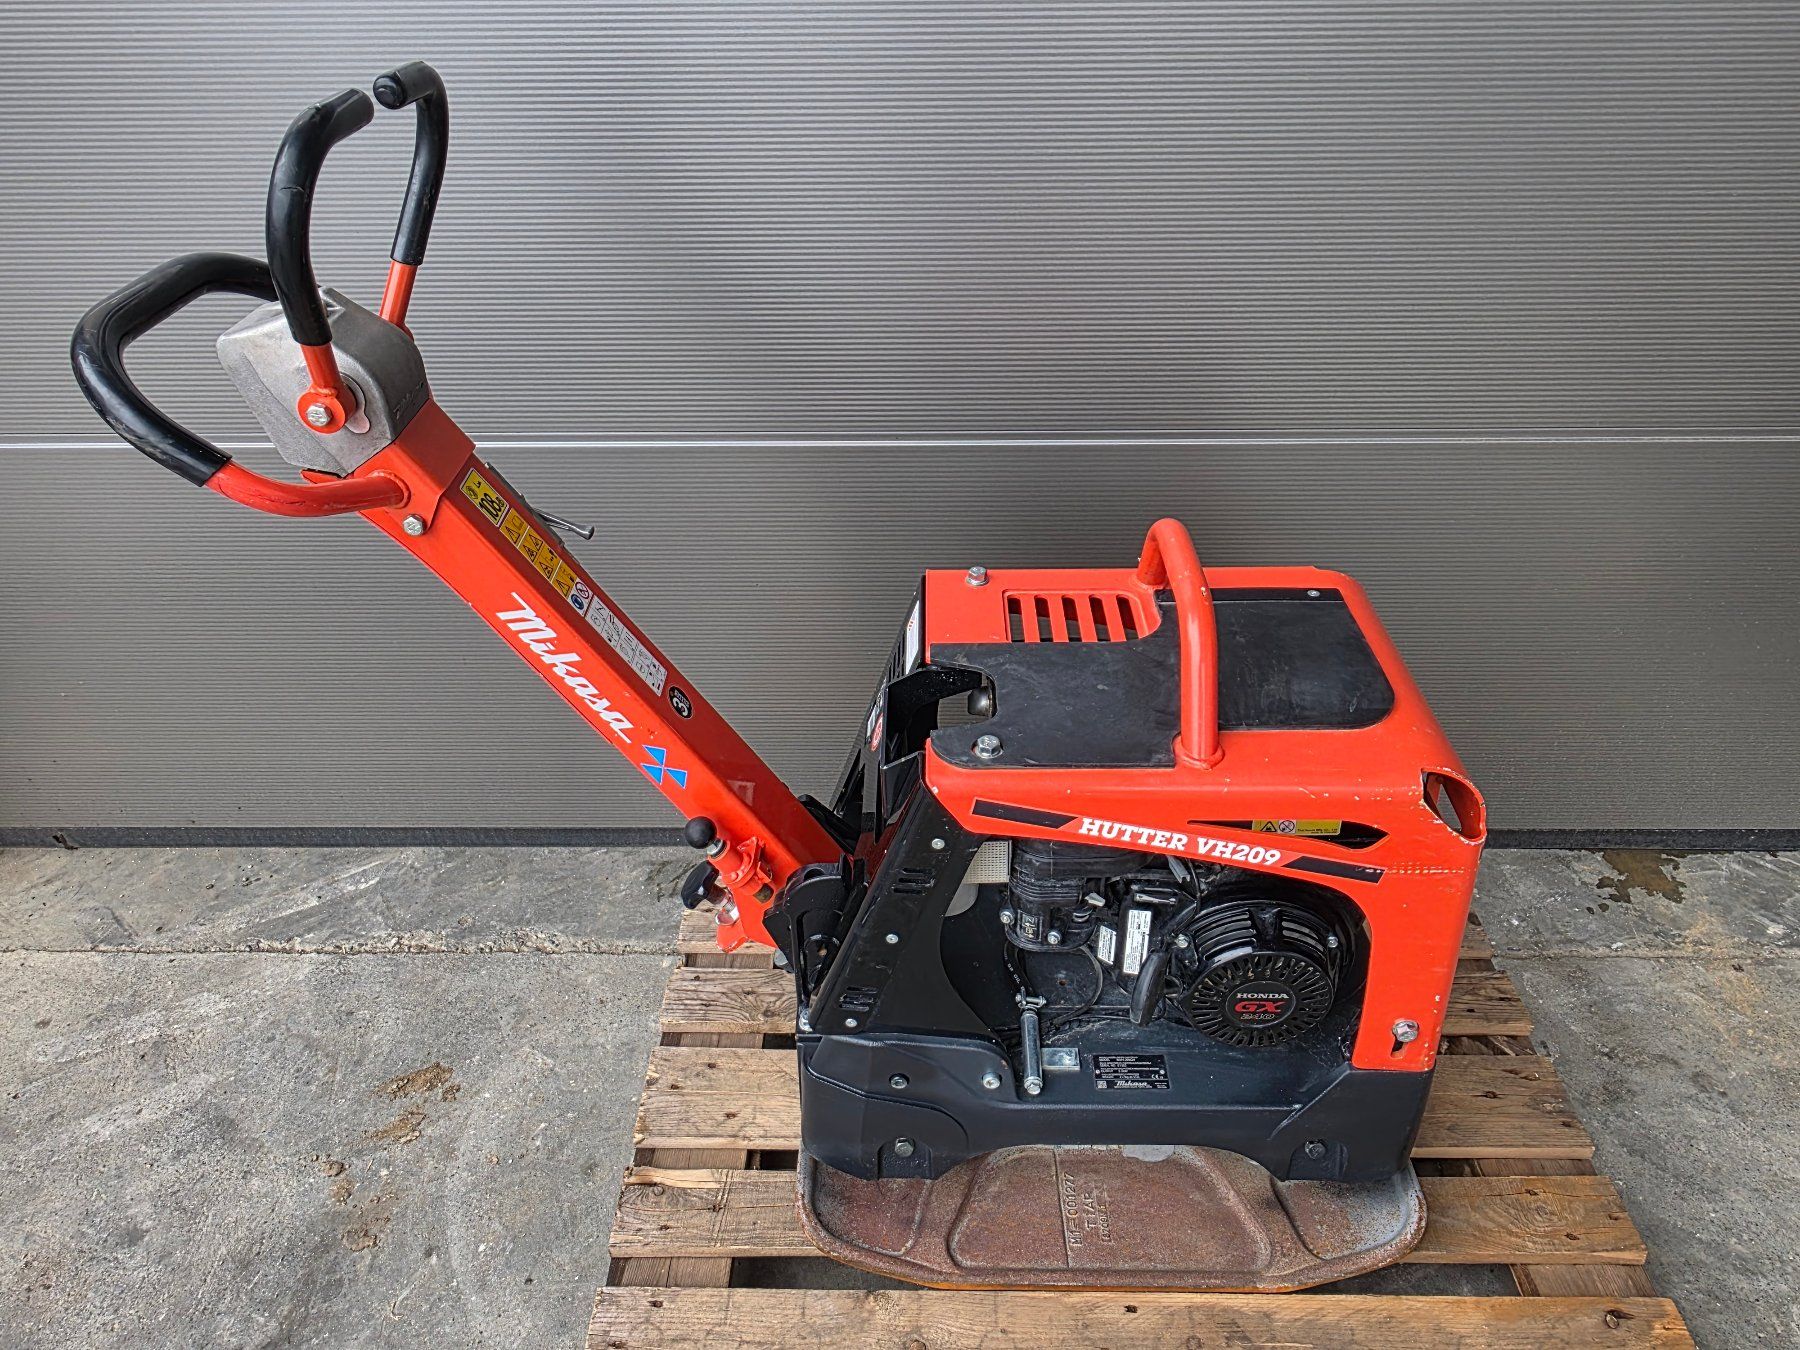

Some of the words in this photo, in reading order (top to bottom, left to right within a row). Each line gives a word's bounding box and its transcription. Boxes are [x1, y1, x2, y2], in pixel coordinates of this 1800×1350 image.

[478, 493, 502, 522] 108
[495, 591, 634, 744] Mikasa
[672, 697, 688, 716] 3
[1078, 817, 1188, 850] HUTTER
[1197, 837, 1281, 866] VH209
[1234, 1001, 1287, 1013] GX
